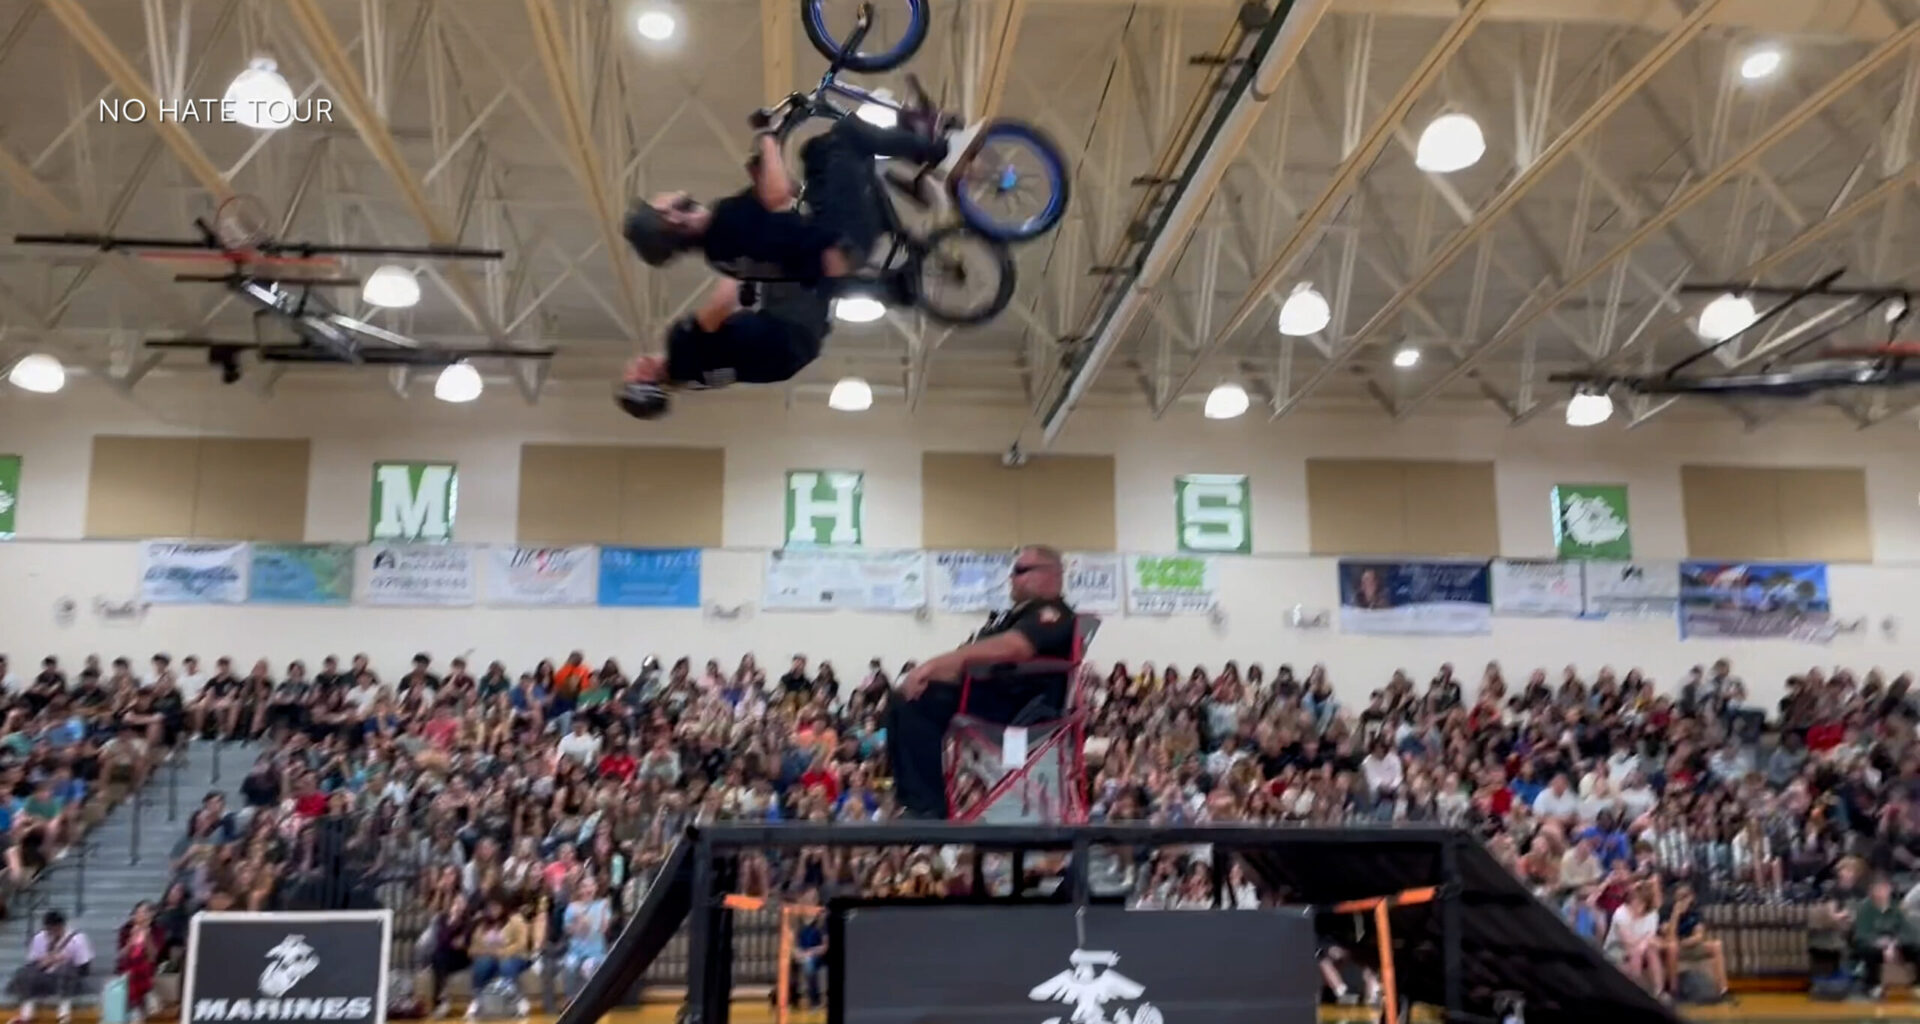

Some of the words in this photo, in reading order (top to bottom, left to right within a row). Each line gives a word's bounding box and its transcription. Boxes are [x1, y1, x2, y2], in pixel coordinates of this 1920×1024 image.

[375, 465, 450, 538] M
[789, 472, 859, 542] H
[1182, 475, 1244, 550] S
[193, 996, 372, 1022] MARINES
